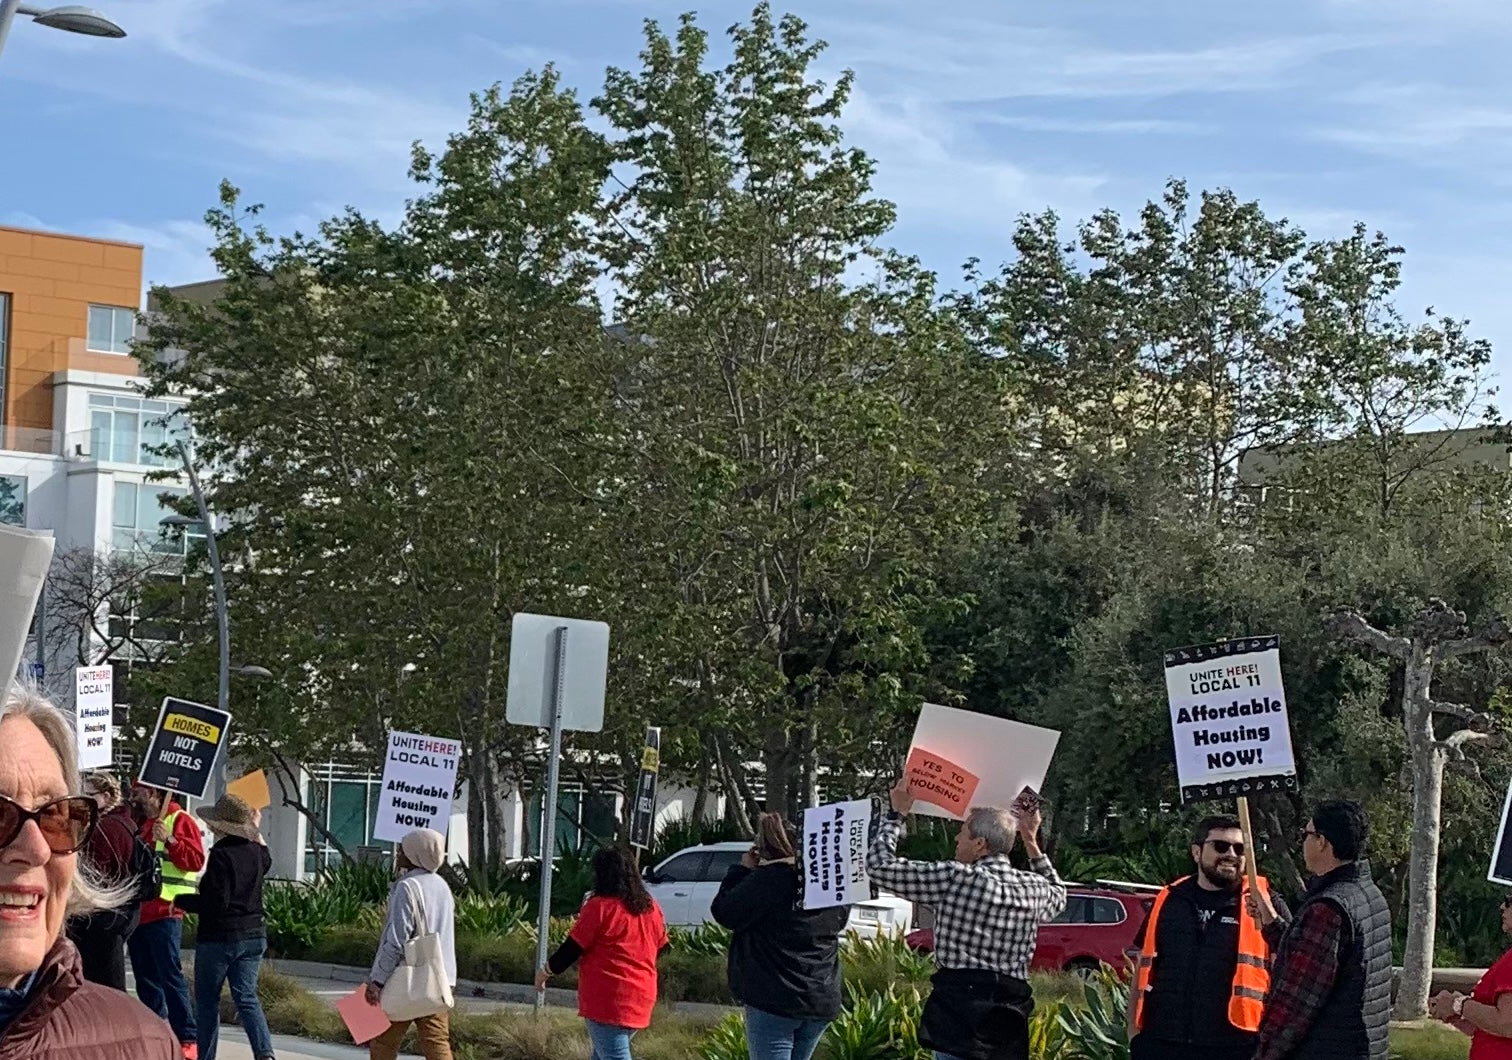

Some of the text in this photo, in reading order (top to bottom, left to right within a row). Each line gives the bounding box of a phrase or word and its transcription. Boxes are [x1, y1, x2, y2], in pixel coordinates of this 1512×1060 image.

[1190, 664, 1258, 683] UNITE HERE!
[1191, 674, 1261, 695] LOCAL 11
[79, 684, 111, 695] LOCAL 11
[1177, 697, 1282, 724] Affordable
[171, 718, 212, 737] HOMES
[1193, 725, 1271, 747] Housing
[173, 735, 200, 751] NOT
[159, 749, 203, 771] HOTELS
[390, 751, 454, 770] LOCAL 11
[1207, 748, 1263, 770] NOW!
[923, 760, 964, 784] YES TO
[387, 780, 449, 800] Affordable
[910, 778, 960, 802] HOUSING
[392, 796, 438, 815] Housing
[395, 813, 430, 828] NOW!
[809, 832, 819, 884] NOW!
[821, 821, 830, 891] Housing
[834, 808, 844, 901] Affordable
[850, 820, 858, 883] LOCAL 11
